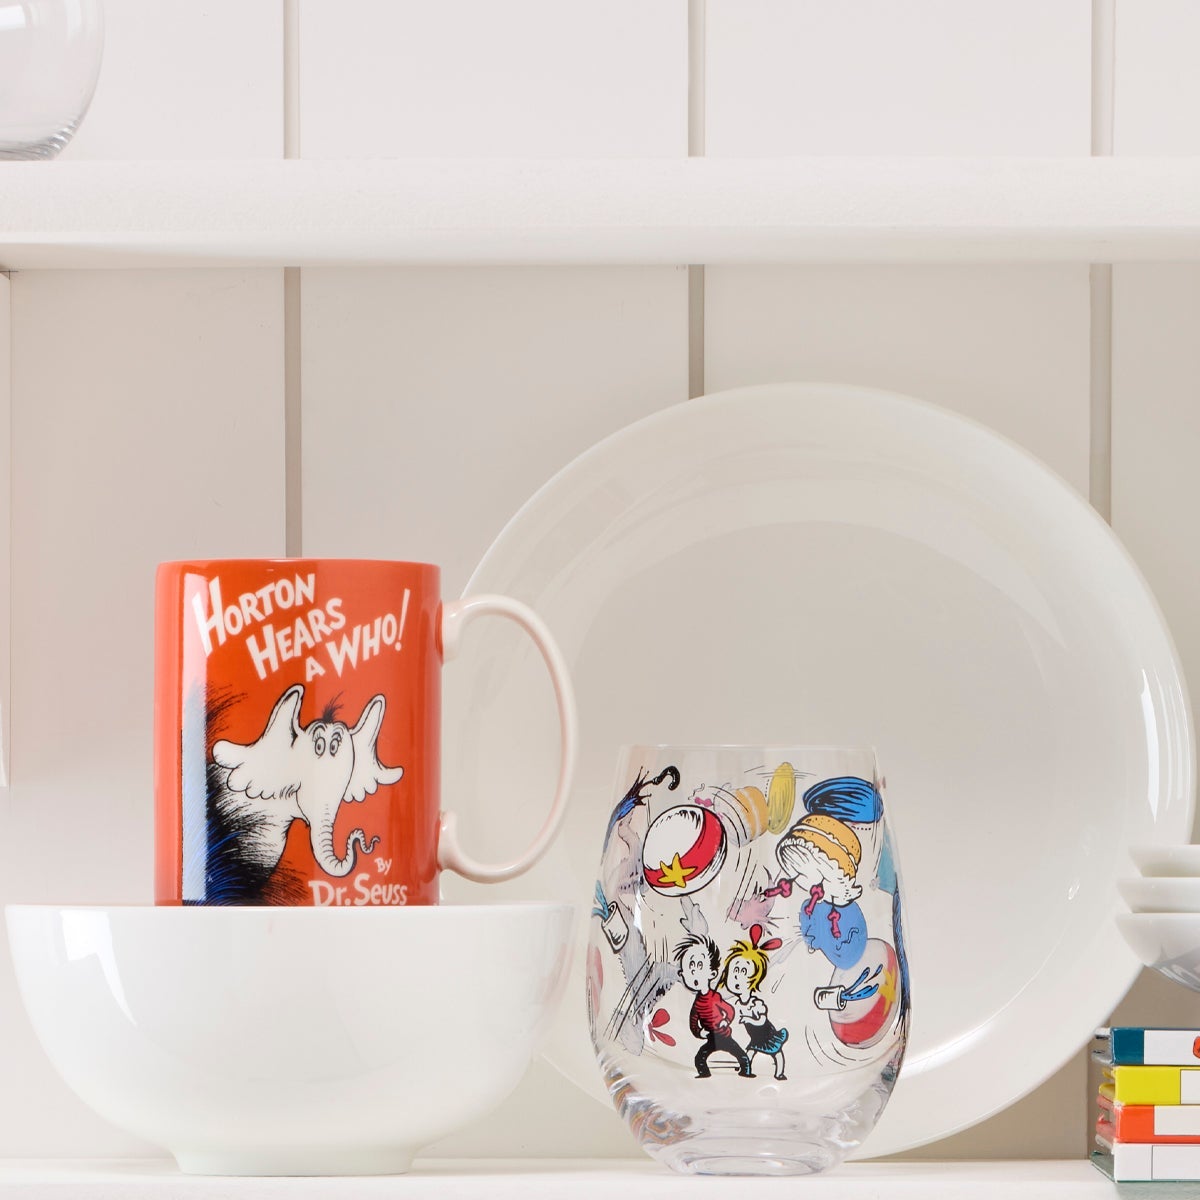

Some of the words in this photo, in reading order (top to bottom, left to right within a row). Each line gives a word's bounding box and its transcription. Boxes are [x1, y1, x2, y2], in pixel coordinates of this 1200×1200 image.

[192, 573, 315, 658] HORTON
[245, 597, 346, 681] HEARS
[305, 656, 326, 682] A
[325, 588, 411, 678] WHO!
[308, 880, 351, 906] Dr.
[353, 873, 408, 906] Seuss
[374, 857, 393, 876] By
